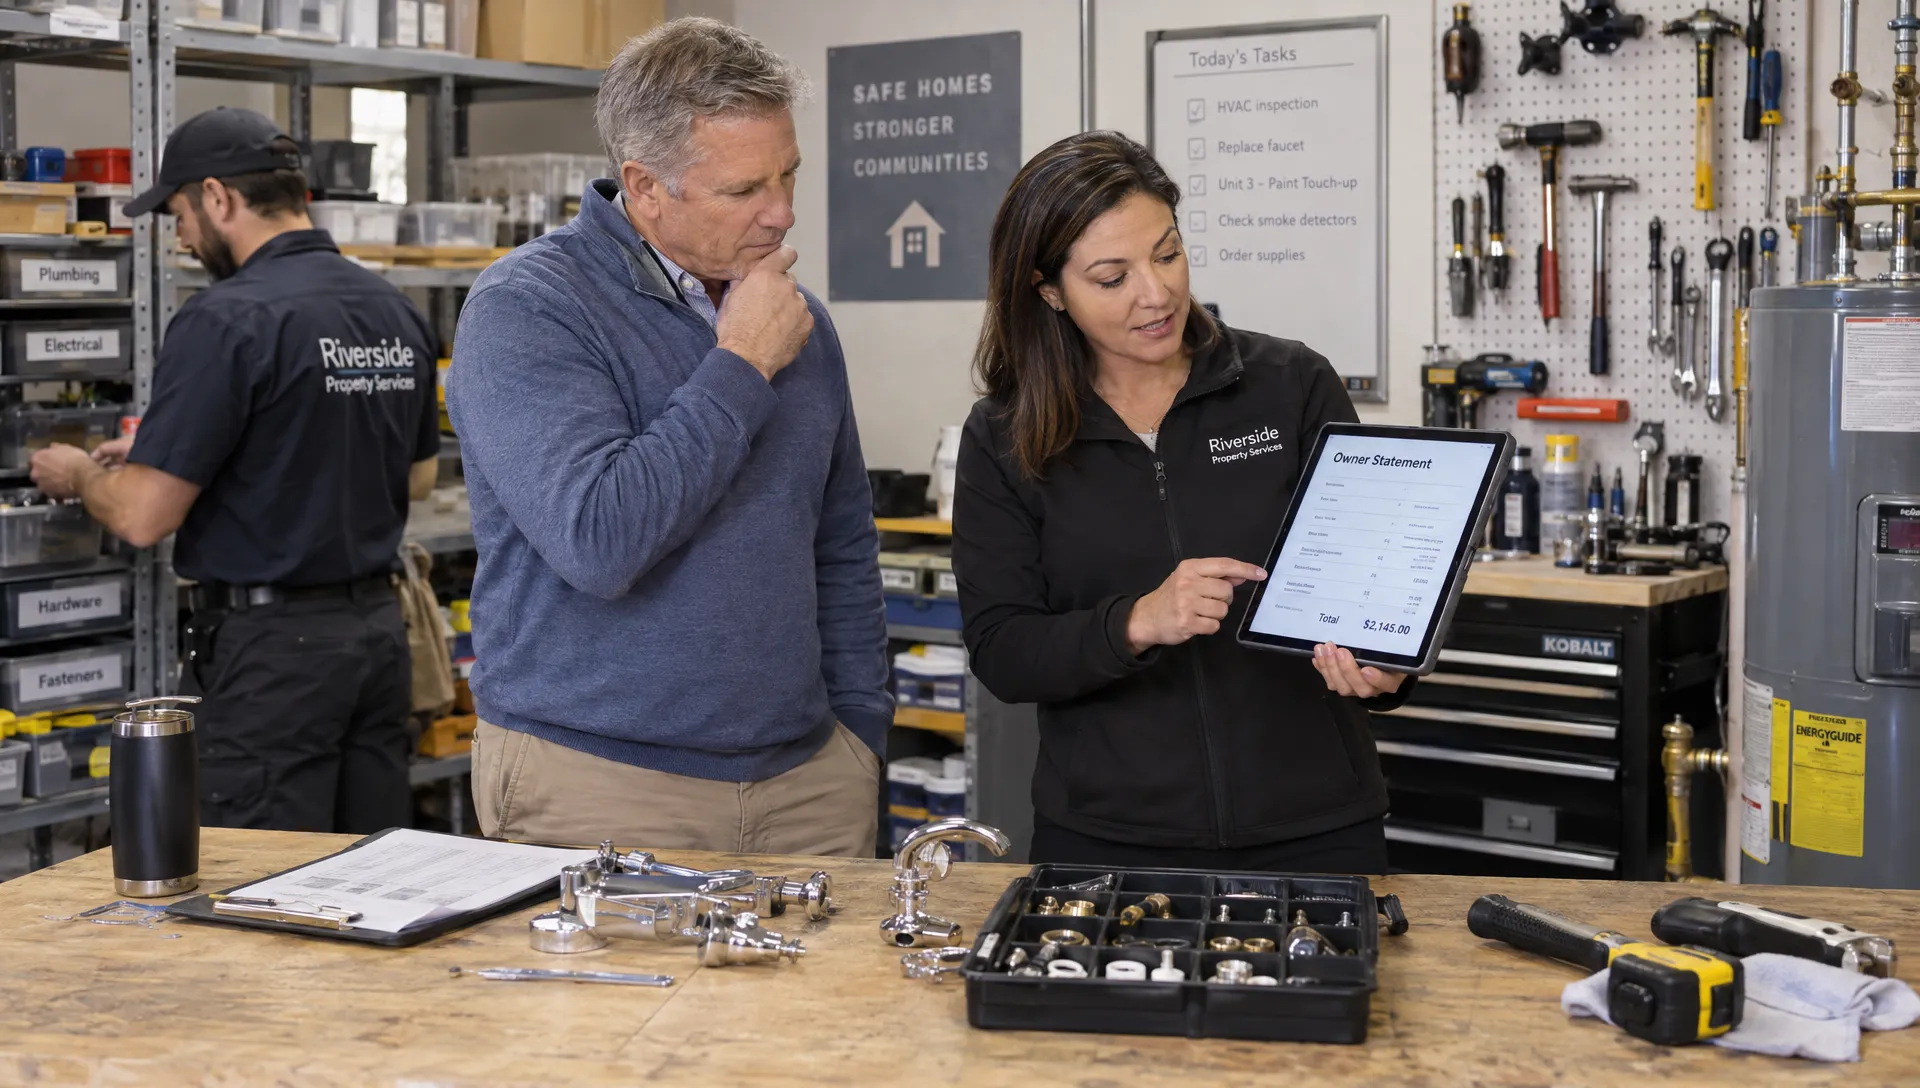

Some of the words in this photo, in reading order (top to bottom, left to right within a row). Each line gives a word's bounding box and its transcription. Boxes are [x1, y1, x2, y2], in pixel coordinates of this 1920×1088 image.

[1189, 49, 1247, 69] Today's
[1253, 45, 1297, 63] Tasks
[853, 80, 906, 104] SAFE
[917, 73, 992, 98] HOMES
[1217, 100, 1252, 114] HVAC
[1256, 97, 1319, 116] inspection
[853, 115, 954, 140] STRONGER
[1218, 141, 1264, 156] Replace
[1268, 139, 1305, 152] faucet
[853, 151, 989, 177] COMMUNITIES
[1218, 177, 1243, 190] Unit
[1246, 177, 1254, 190] 3
[1268, 177, 1299, 190] Paint
[1302, 176, 1358, 191] Touch-up
[1218, 214, 1254, 227] Check
[1258, 213, 1296, 226] smoke
[1300, 213, 1357, 226] detectors
[1219, 249, 1252, 262] Order
[1257, 248, 1305, 264] supplies
[39, 266, 100, 285] Plumbing
[44, 336, 103, 353] Electrical
[318, 337, 415, 368] Riverside
[325, 375, 373, 395] Property
[374, 373, 416, 391] Services
[1208, 426, 1279, 452] Riverside
[1212, 451, 1248, 464] Property
[1249, 443, 1283, 456] Services
[1333, 452, 1371, 465] Owner
[1371, 455, 1433, 469] Statement
[38, 596, 103, 614] Hardware
[1318, 612, 1340, 624] Total
[1362, 619, 1411, 635] $2,145.00
[1544, 637, 1612, 656] KOBALT
[38, 668, 104, 689] Fasteners
[1796, 724, 1863, 745] ENERGYGUIDE
